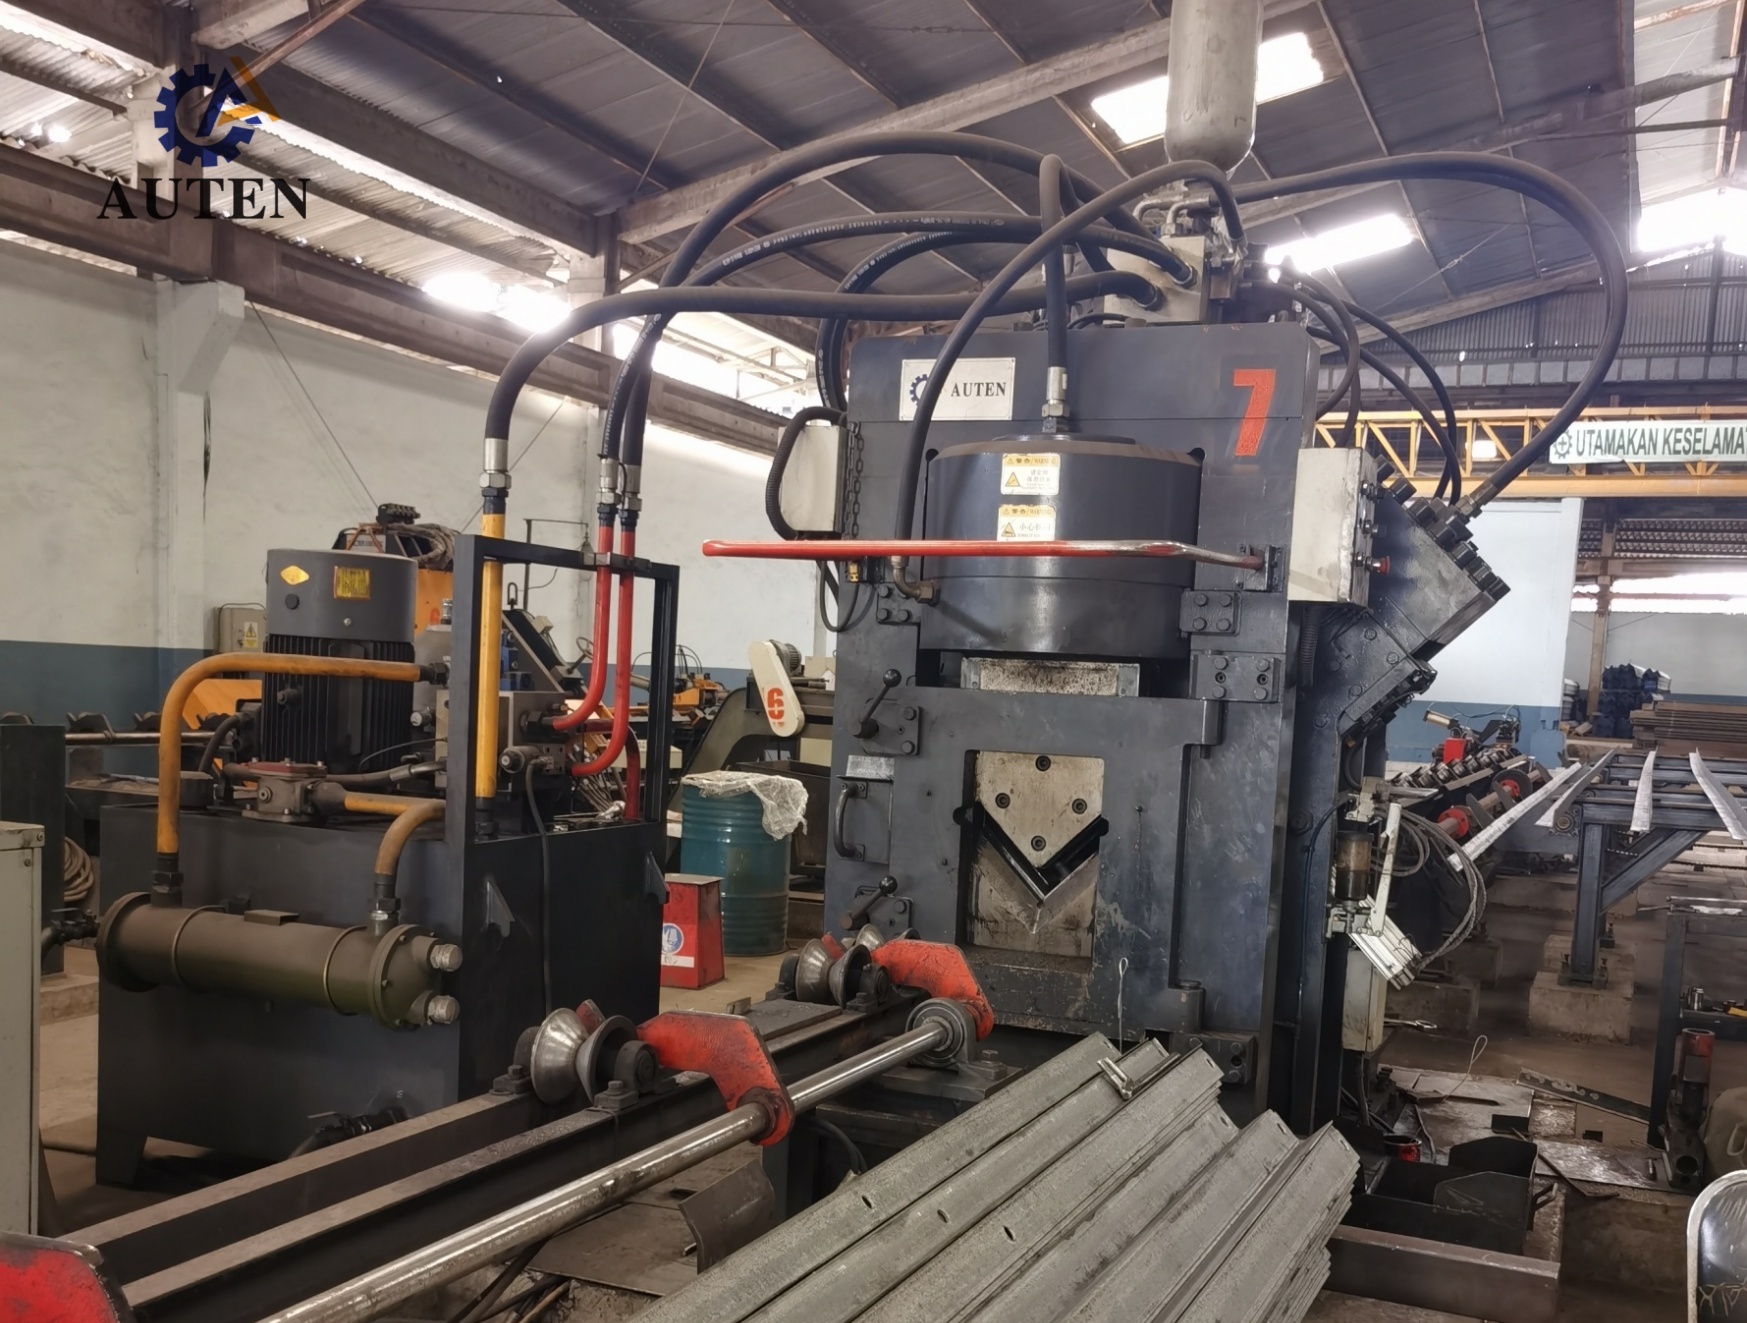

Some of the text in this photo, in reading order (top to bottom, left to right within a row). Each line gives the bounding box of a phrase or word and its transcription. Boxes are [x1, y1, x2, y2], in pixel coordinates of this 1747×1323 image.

[951, 382, 1006, 397] AUTEN
[1233, 369, 1275, 456] 7
[1576, 427, 1747, 457] UTAMAKAN KESELAMA
[767, 688, 784, 719] 6
